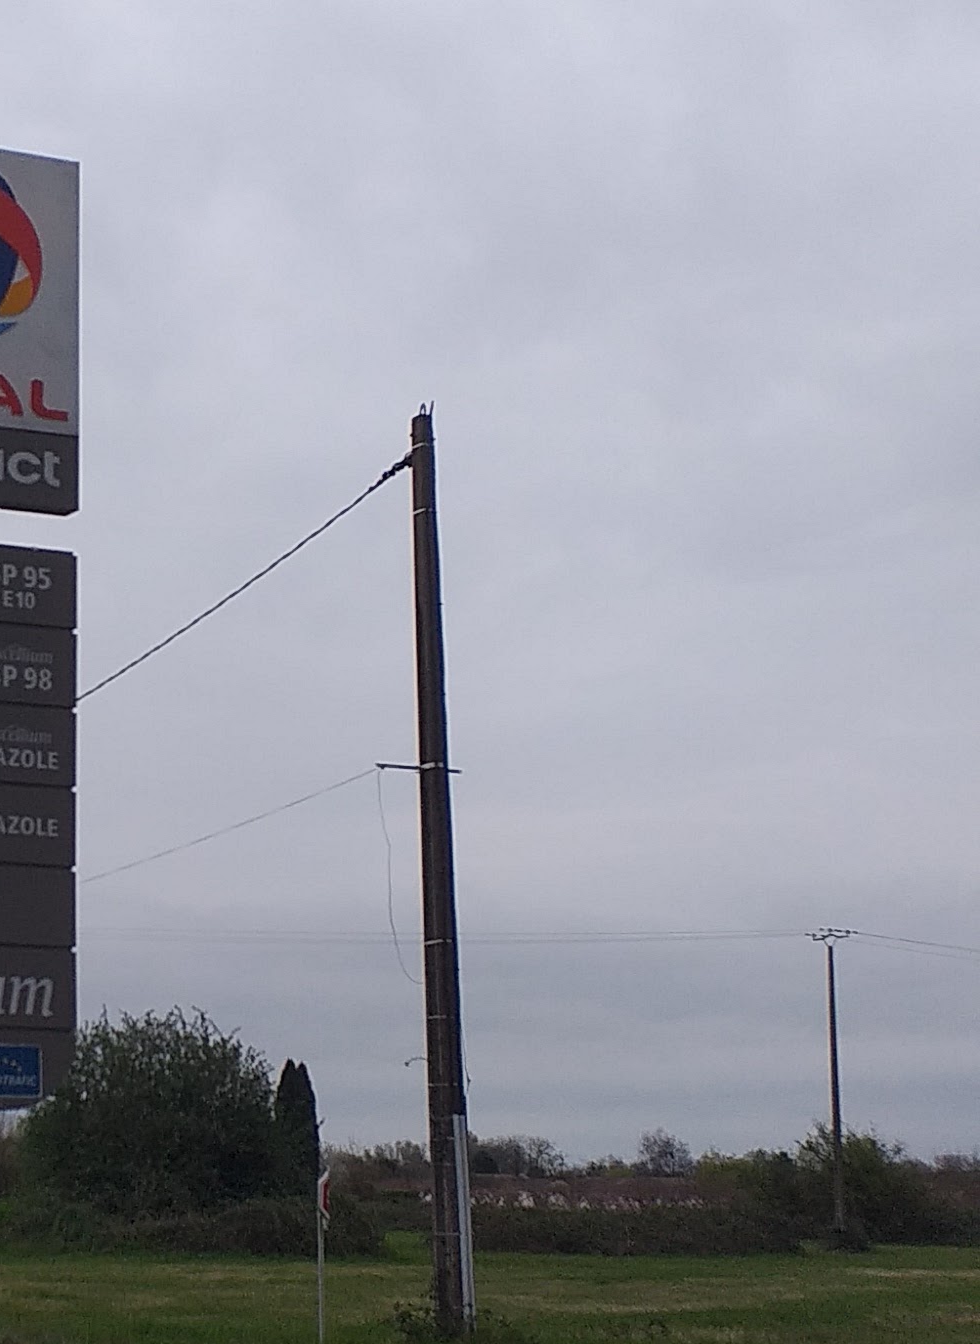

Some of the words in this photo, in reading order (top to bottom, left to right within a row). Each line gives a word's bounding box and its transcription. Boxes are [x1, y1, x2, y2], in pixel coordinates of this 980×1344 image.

[22, 566, 52, 590] 95
[3, 590, 36, 609] E10
[23, 667, 53, 691] 98
